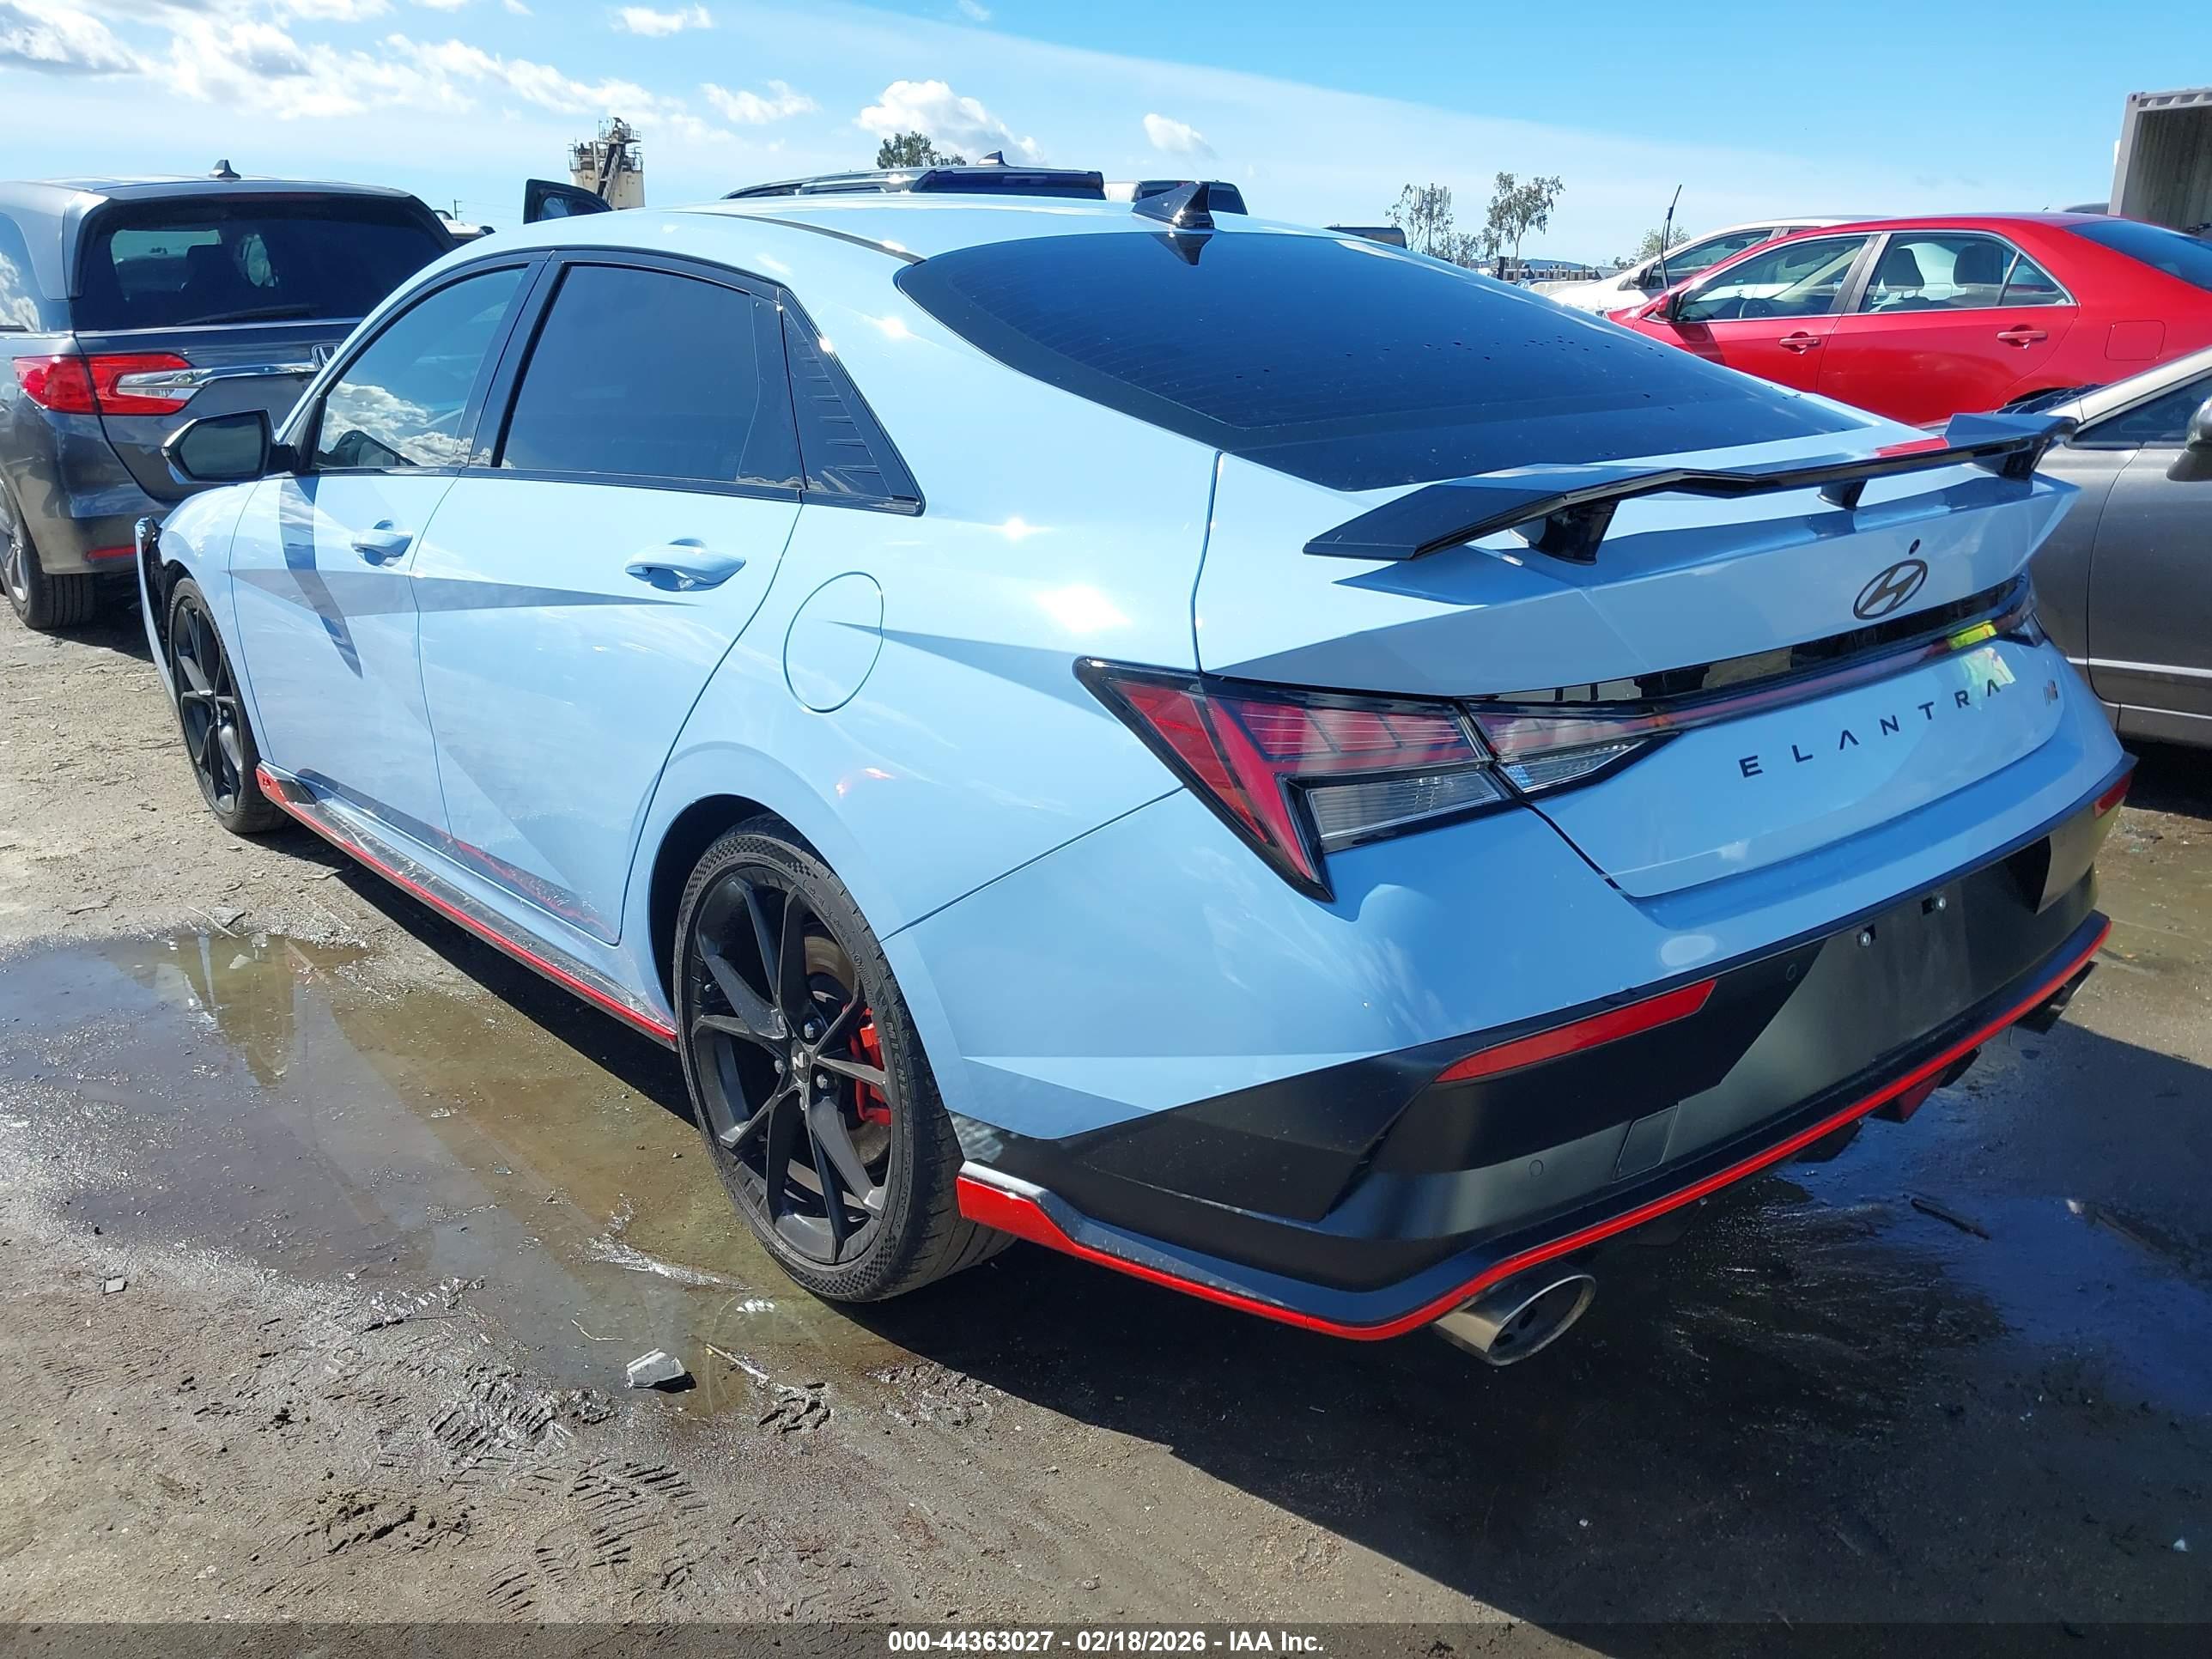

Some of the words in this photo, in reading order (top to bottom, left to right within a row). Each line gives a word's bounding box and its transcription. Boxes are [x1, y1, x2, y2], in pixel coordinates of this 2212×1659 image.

[1739, 678, 2000, 779] ELANTRA
[792, 1051, 805, 1071] N
[884, 1021, 913, 1139] MICHELIN
